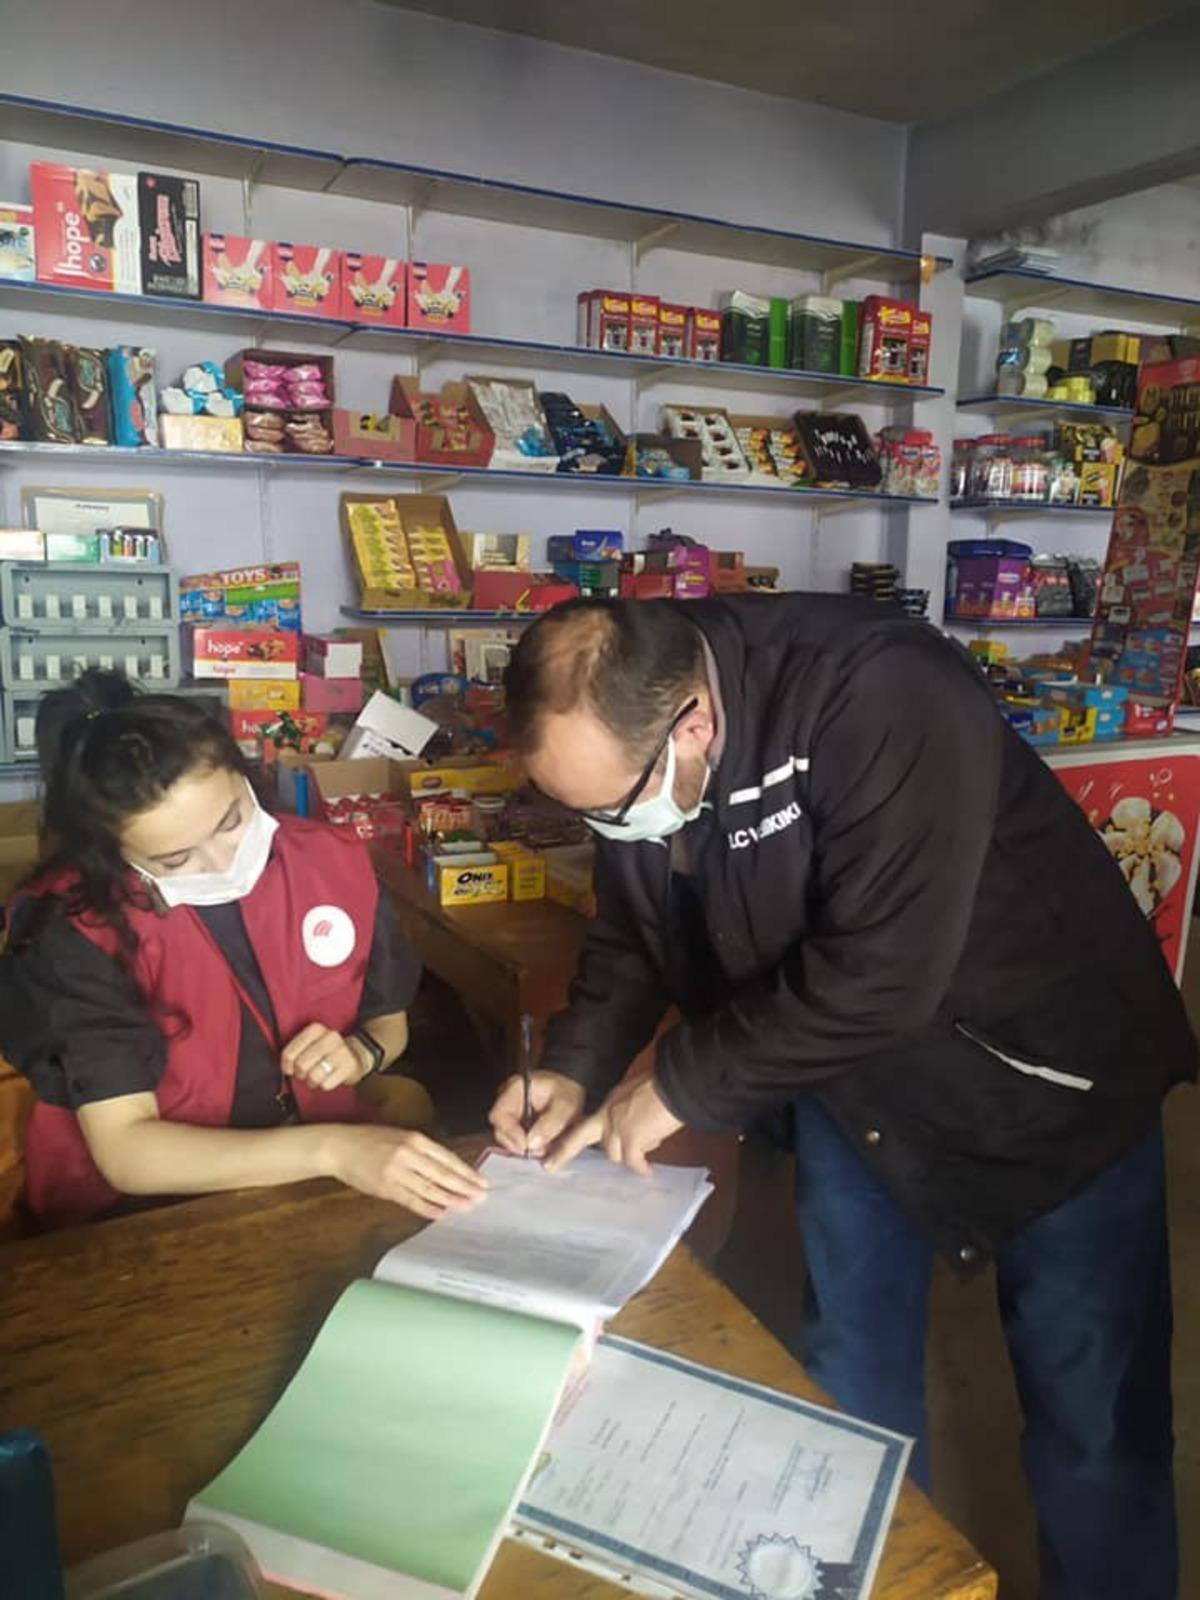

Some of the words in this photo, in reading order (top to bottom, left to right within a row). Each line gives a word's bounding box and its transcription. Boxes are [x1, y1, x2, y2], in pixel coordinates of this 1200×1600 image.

[62, 212, 90, 269] hope
[222, 568, 266, 585] TOYS
[207, 639, 241, 658] hope
[728, 829, 750, 850] LC
